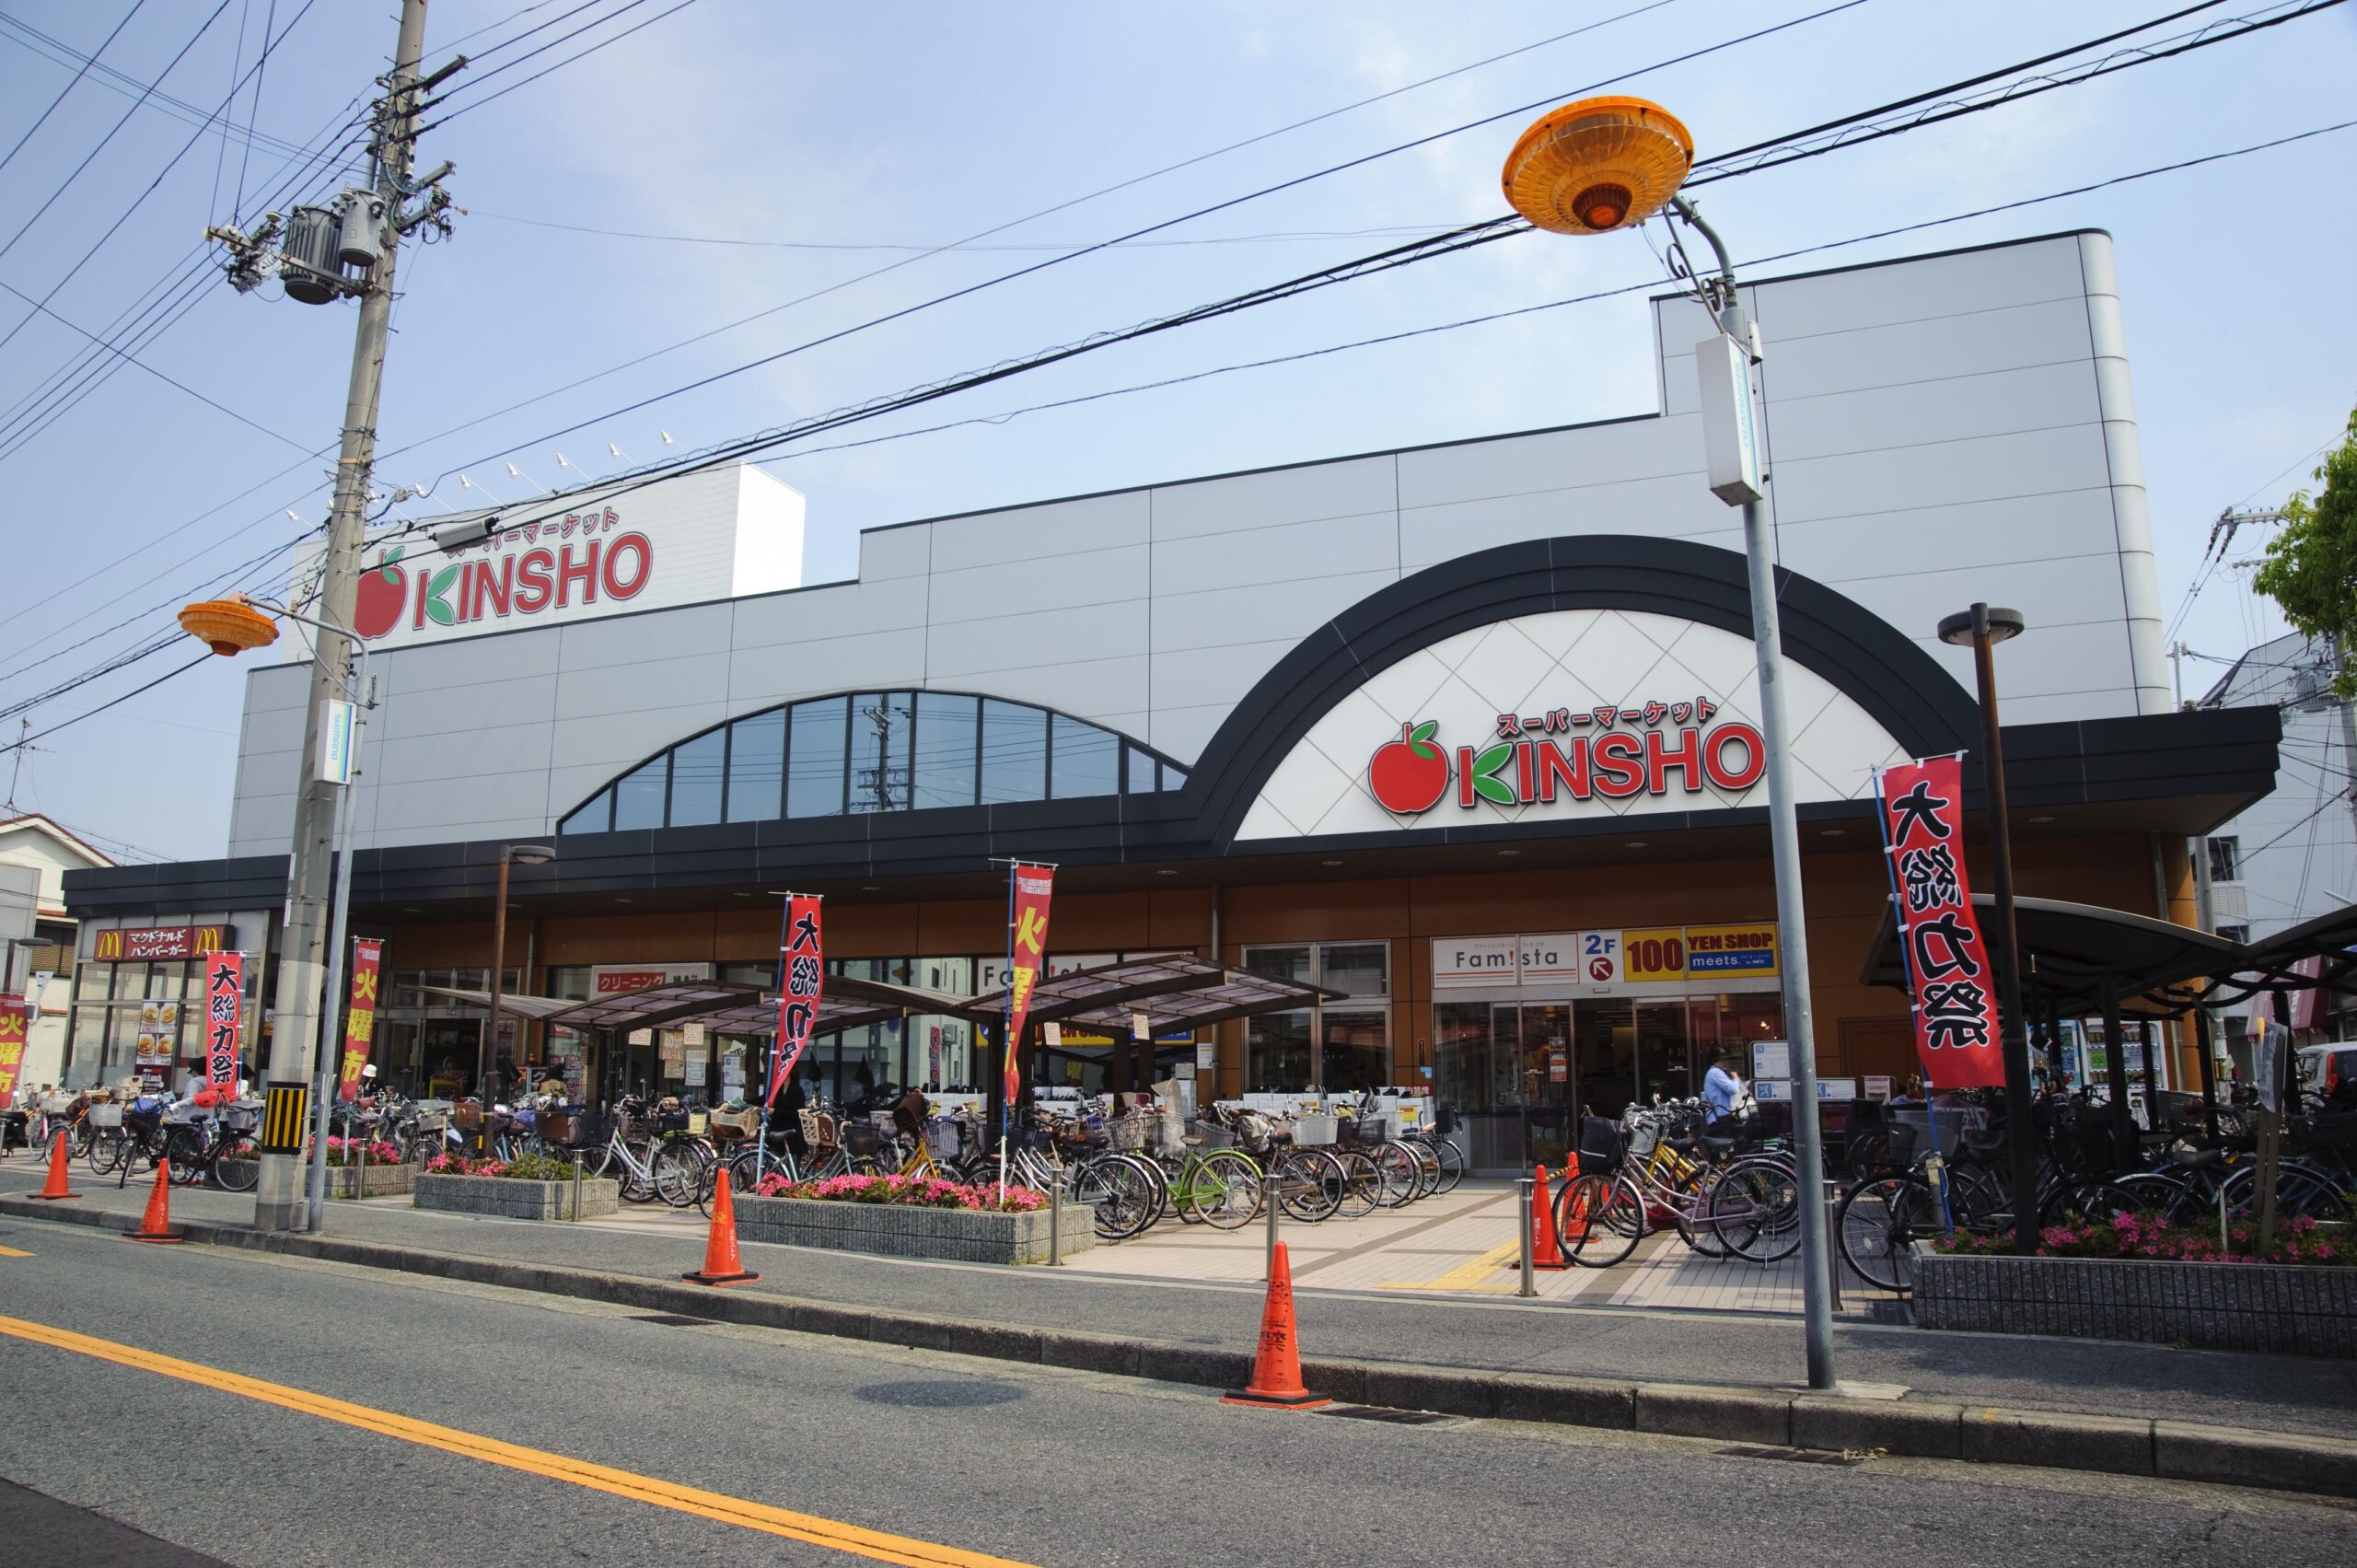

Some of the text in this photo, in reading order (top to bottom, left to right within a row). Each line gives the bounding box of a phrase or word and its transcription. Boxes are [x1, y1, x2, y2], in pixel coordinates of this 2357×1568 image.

[446, 505, 621, 559] パーマーケット
[412, 531, 654, 631] KINSHO
[1496, 695, 1718, 739] スーパーマーケット
[1457, 721, 1767, 809] KINSHO
[130, 928, 187, 943] マクドナルド
[130, 944, 188, 958] ハンバーガー
[1585, 935, 1616, 955] 2F
[1626, 933, 1773, 973] 100 YEN SHOP
[600, 974, 664, 990] クリーニング
[1692, 955, 1738, 968] meets
[210, 963, 239, 1085] 大総力祭
[341, 968, 378, 1083] 火曜市
